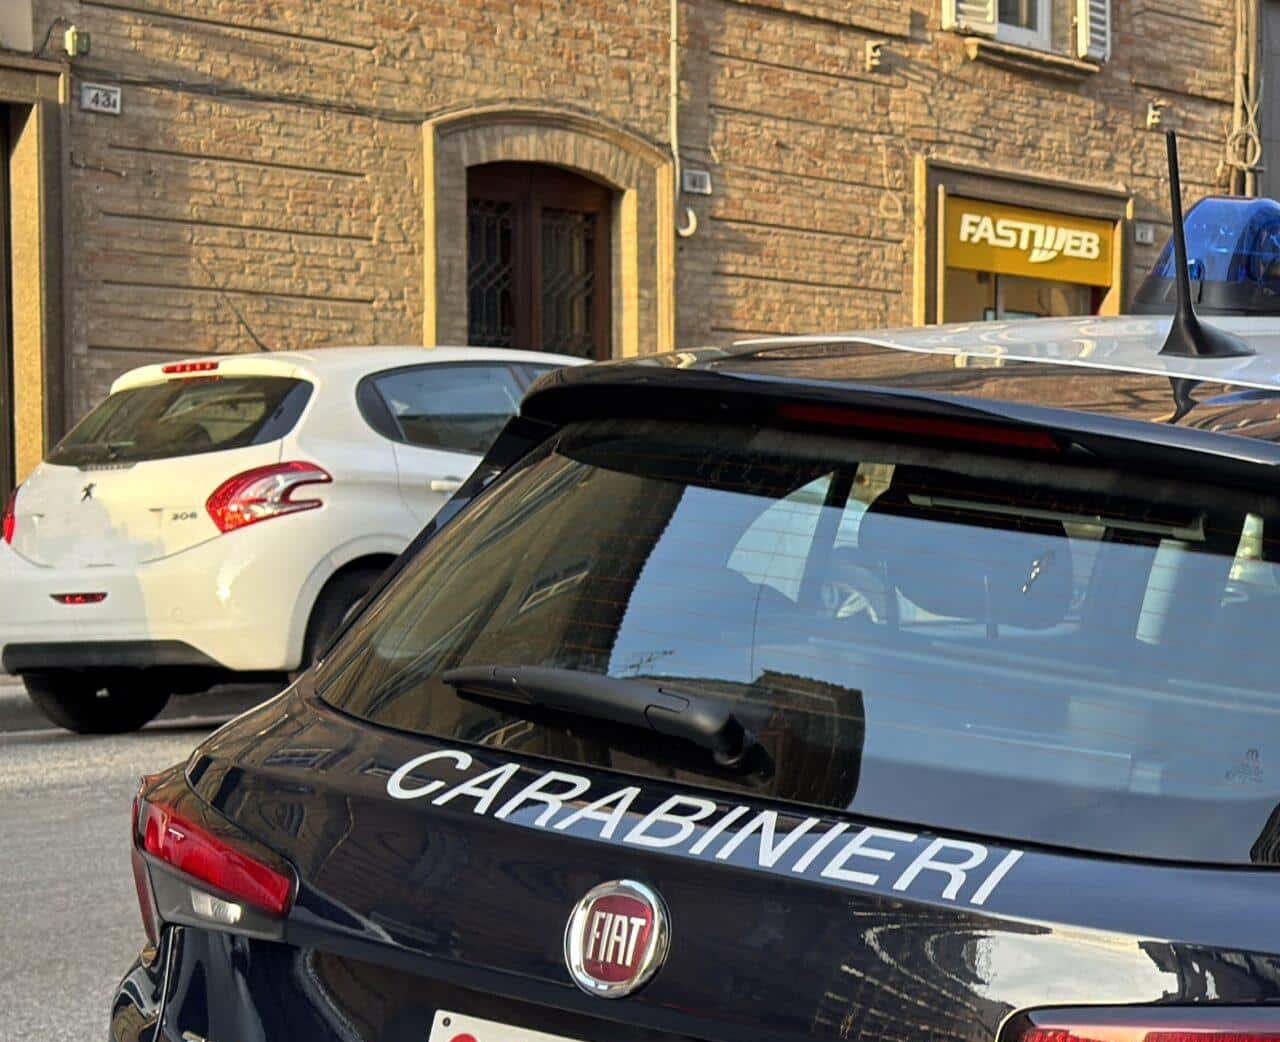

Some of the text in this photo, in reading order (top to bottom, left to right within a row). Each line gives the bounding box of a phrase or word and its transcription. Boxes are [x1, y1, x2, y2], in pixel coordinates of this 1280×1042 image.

[959, 213, 1101, 264] FASTWEB
[386, 750, 1024, 906] CARABINIERI
[586, 910, 646, 967] FIAT
